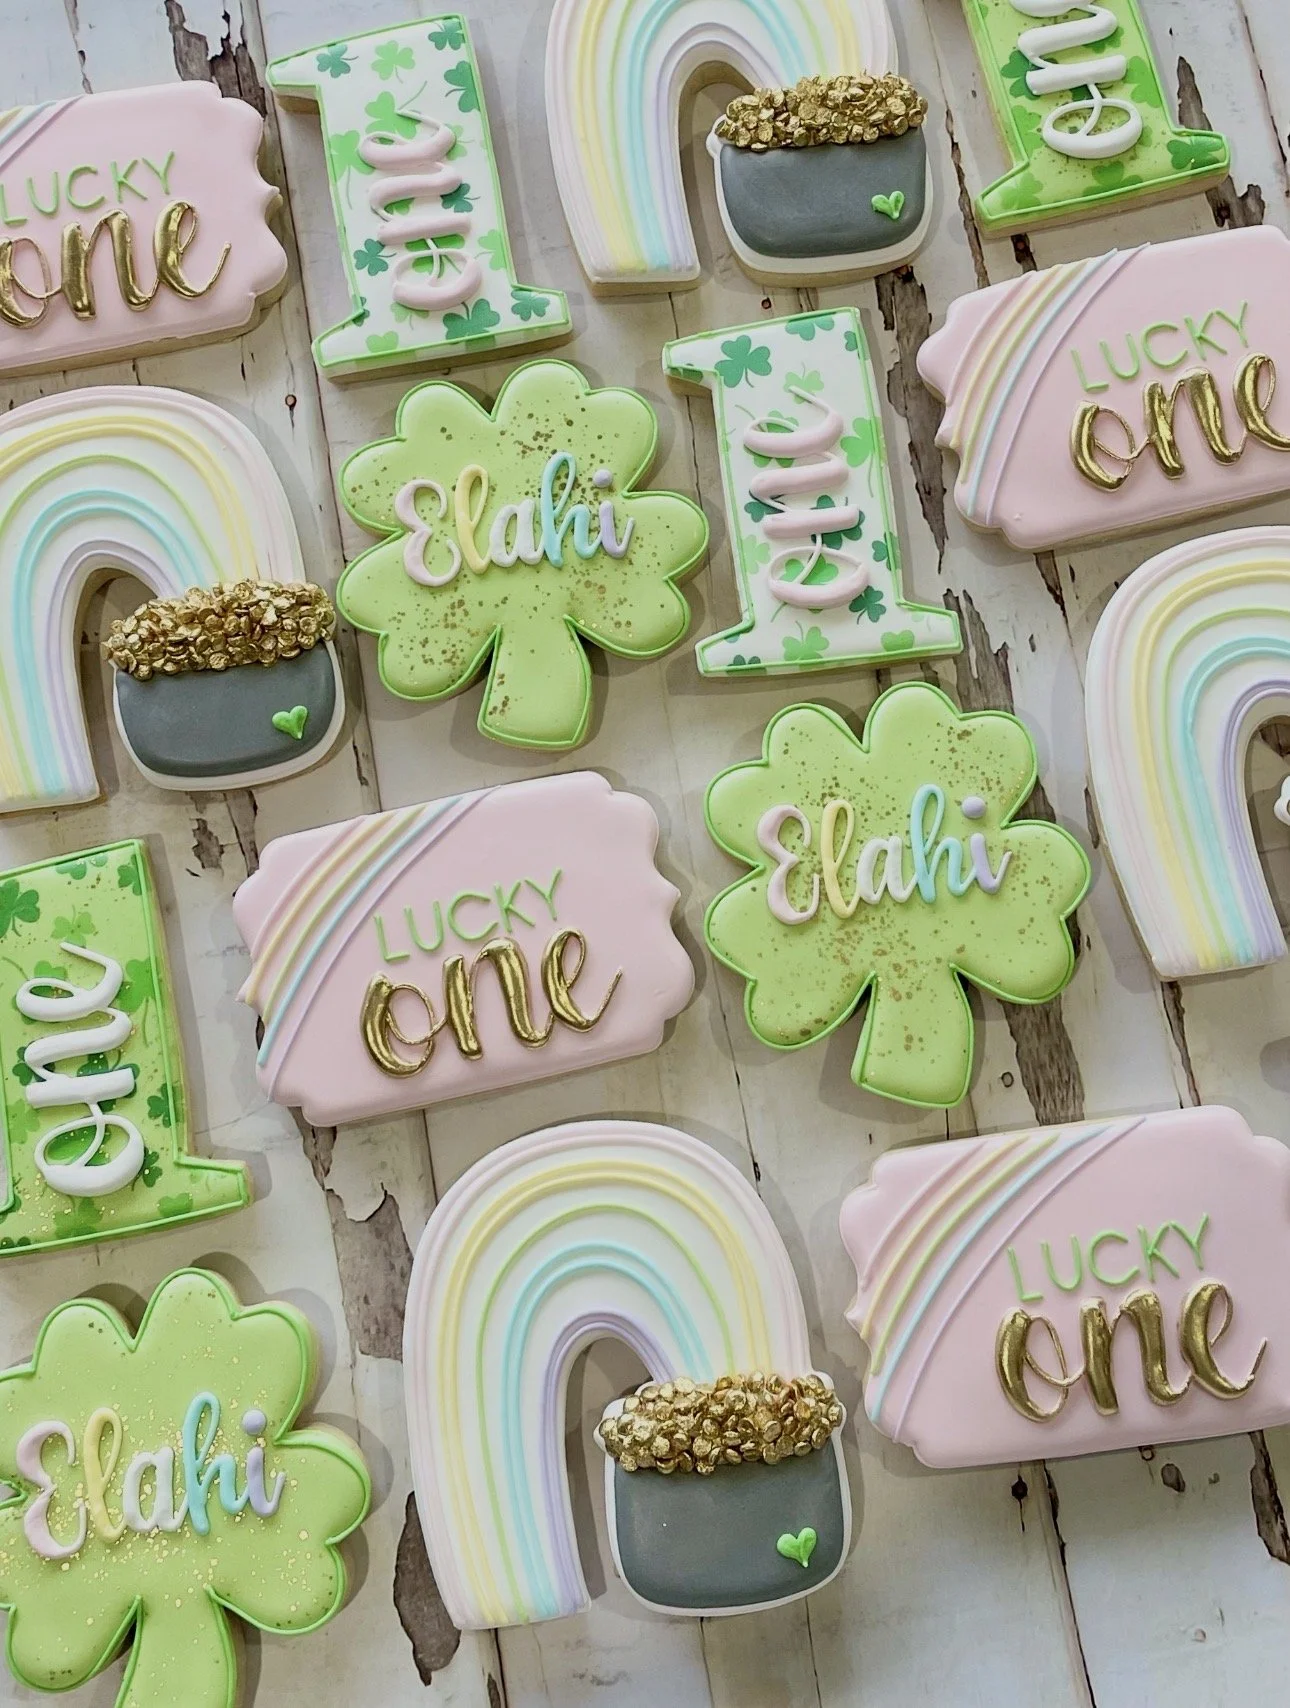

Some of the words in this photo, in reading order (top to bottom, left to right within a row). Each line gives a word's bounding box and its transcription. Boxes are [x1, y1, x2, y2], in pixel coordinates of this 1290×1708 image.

[0, 150, 176, 226] LUCKY
[357, 107, 484, 312] one
[0, 199, 232, 329] one
[1070, 301, 1249, 393] LUCKY
[1068, 352, 1290, 493] one
[394, 451, 636, 588] Elahi
[742, 385, 870, 610] one
[372, 867, 564, 962] LUCKY
[756, 784, 1013, 926] Elahi
[15, 942, 146, 1197] one
[359, 928, 625, 1079] one
[1007, 1213, 1209, 1302] LUCKY
[994, 1279, 1269, 1424] one
[16, 1391, 287, 1560] Elahi
